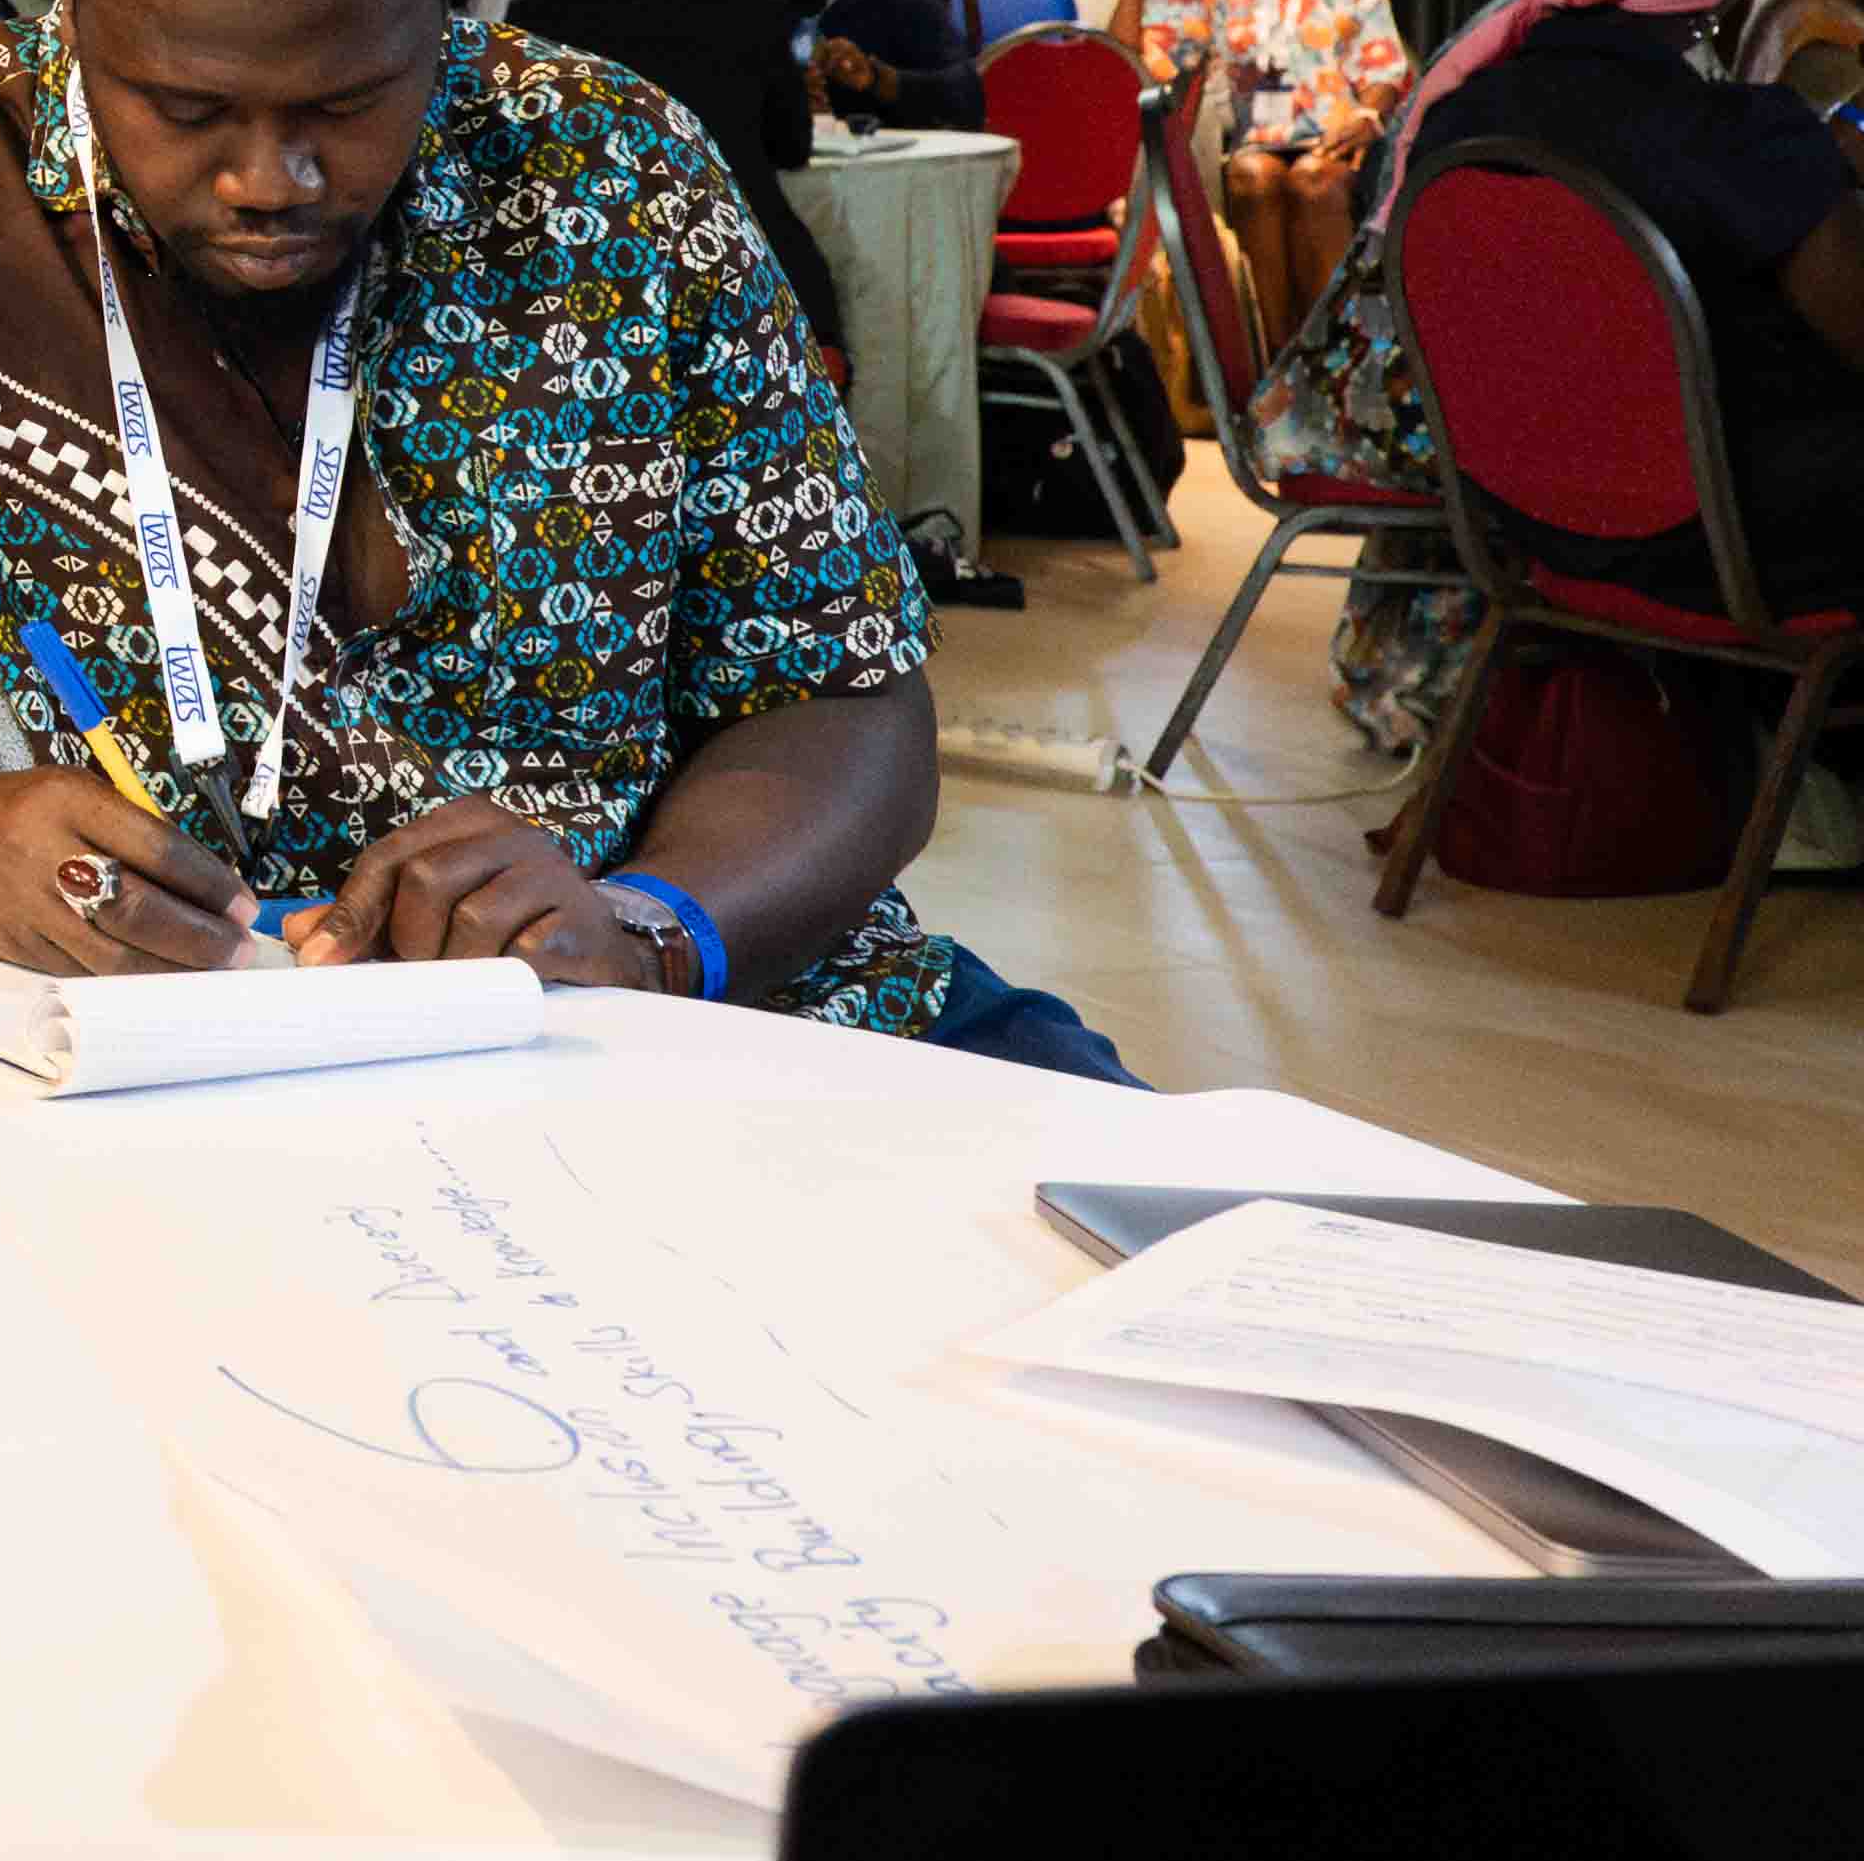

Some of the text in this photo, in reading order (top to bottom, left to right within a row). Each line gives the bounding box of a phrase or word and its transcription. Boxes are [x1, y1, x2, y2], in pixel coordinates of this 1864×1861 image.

[314, 303, 355, 393] twas
[117, 380, 152, 459] twas
[302, 440, 343, 521] twas
[138, 510, 180, 590] twas
[165, 643, 207, 725] twas
